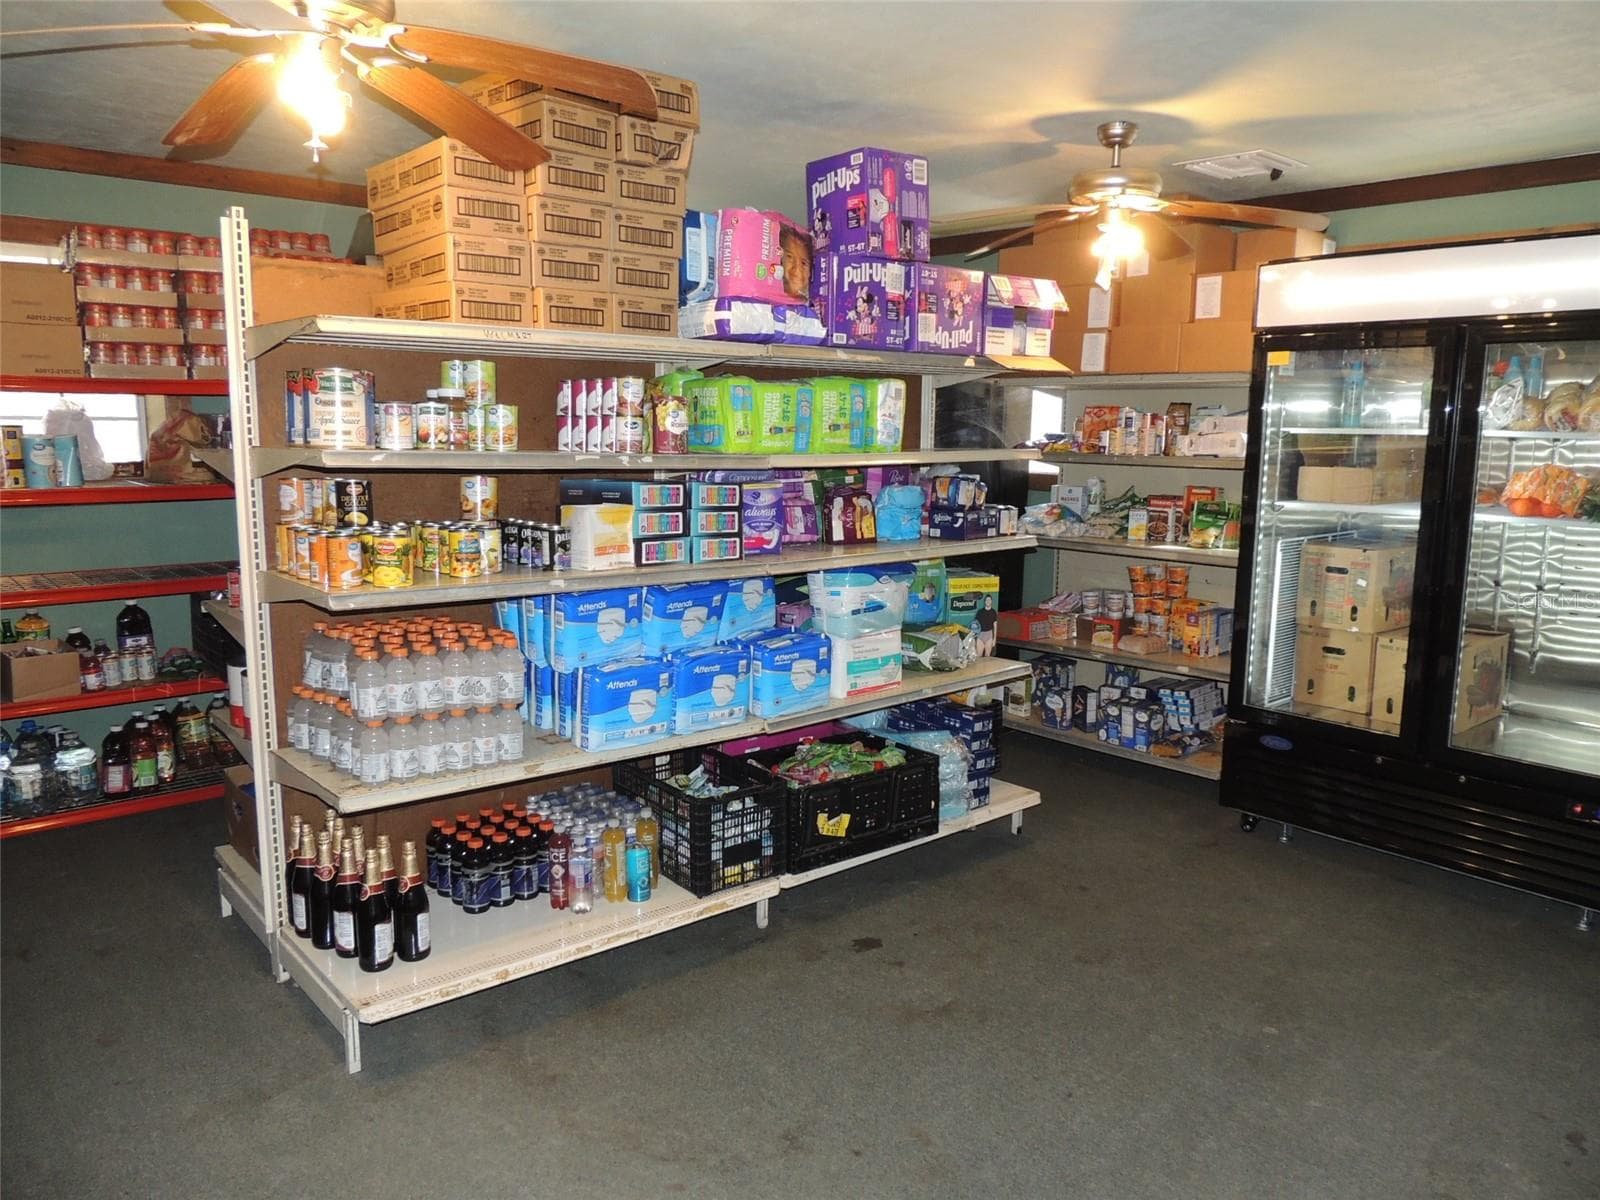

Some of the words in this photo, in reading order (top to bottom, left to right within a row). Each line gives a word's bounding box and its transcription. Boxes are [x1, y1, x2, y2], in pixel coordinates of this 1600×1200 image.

[812, 167, 860, 210] Pull-Ups
[761, 219, 771, 260] PREMIUM
[723, 229, 734, 276] PREMIUM
[745, 506, 777, 520] always
[577, 601, 607, 613] Attends
[666, 600, 694, 611] Attends
[953, 600, 976, 609] Depend
[775, 653, 800, 662] Attends
[693, 664, 721, 674] Attends
[606, 678, 638, 690] Attends
